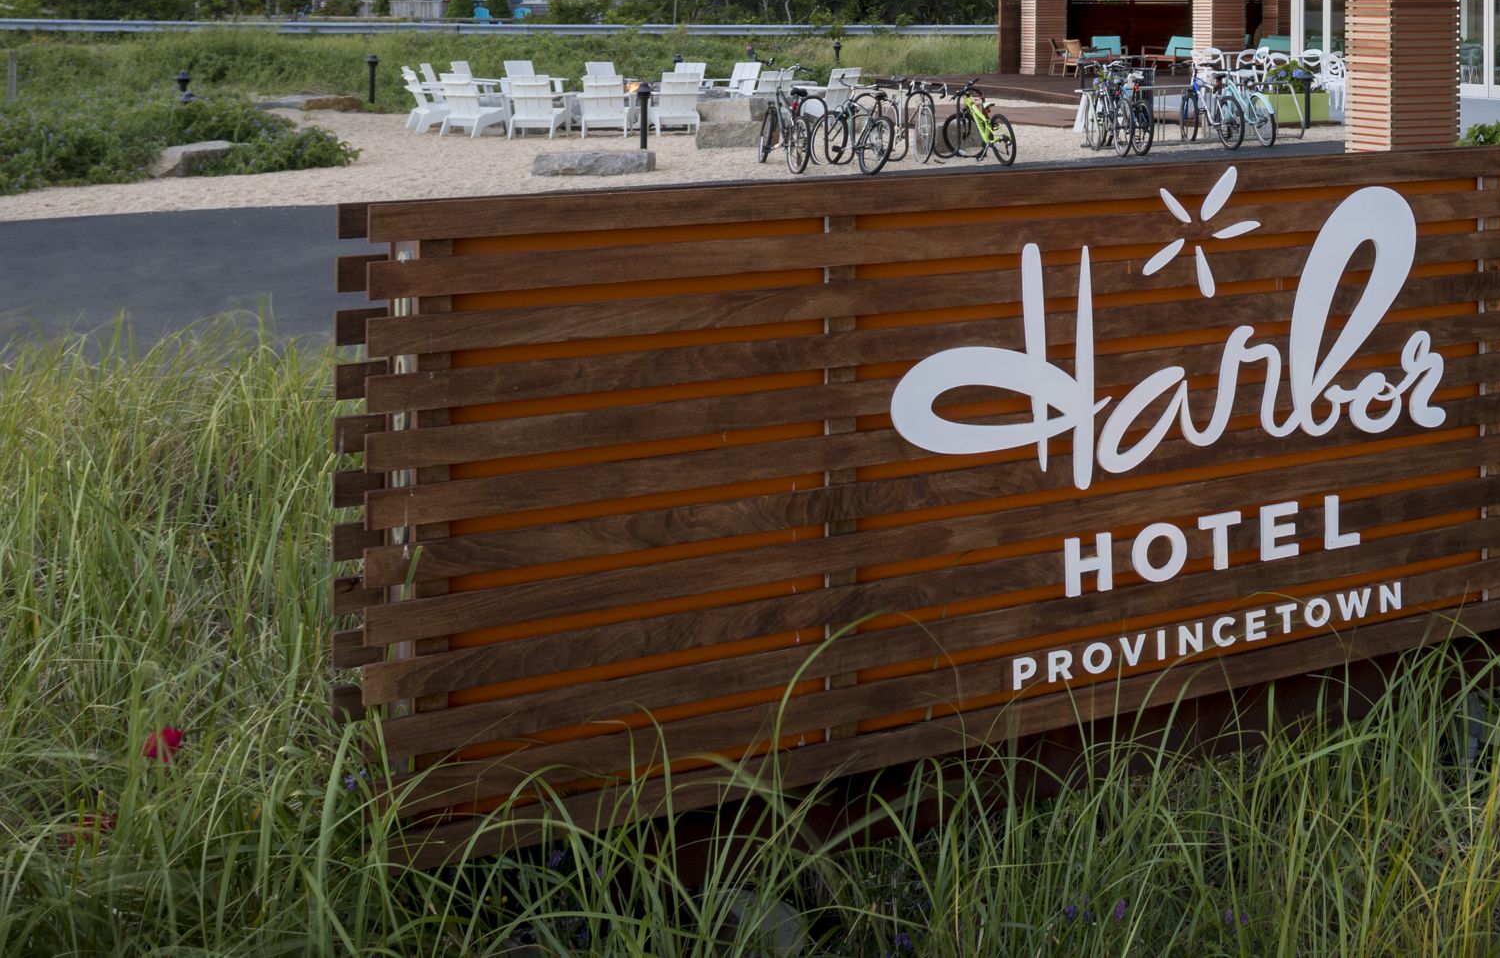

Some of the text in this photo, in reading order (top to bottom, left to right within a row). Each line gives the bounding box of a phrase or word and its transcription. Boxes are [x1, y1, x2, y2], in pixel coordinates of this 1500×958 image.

[890, 185, 1447, 491] Harbor
[1064, 495, 1361, 598] HOTEL
[1012, 582, 1402, 691] PROVINCETOWN
